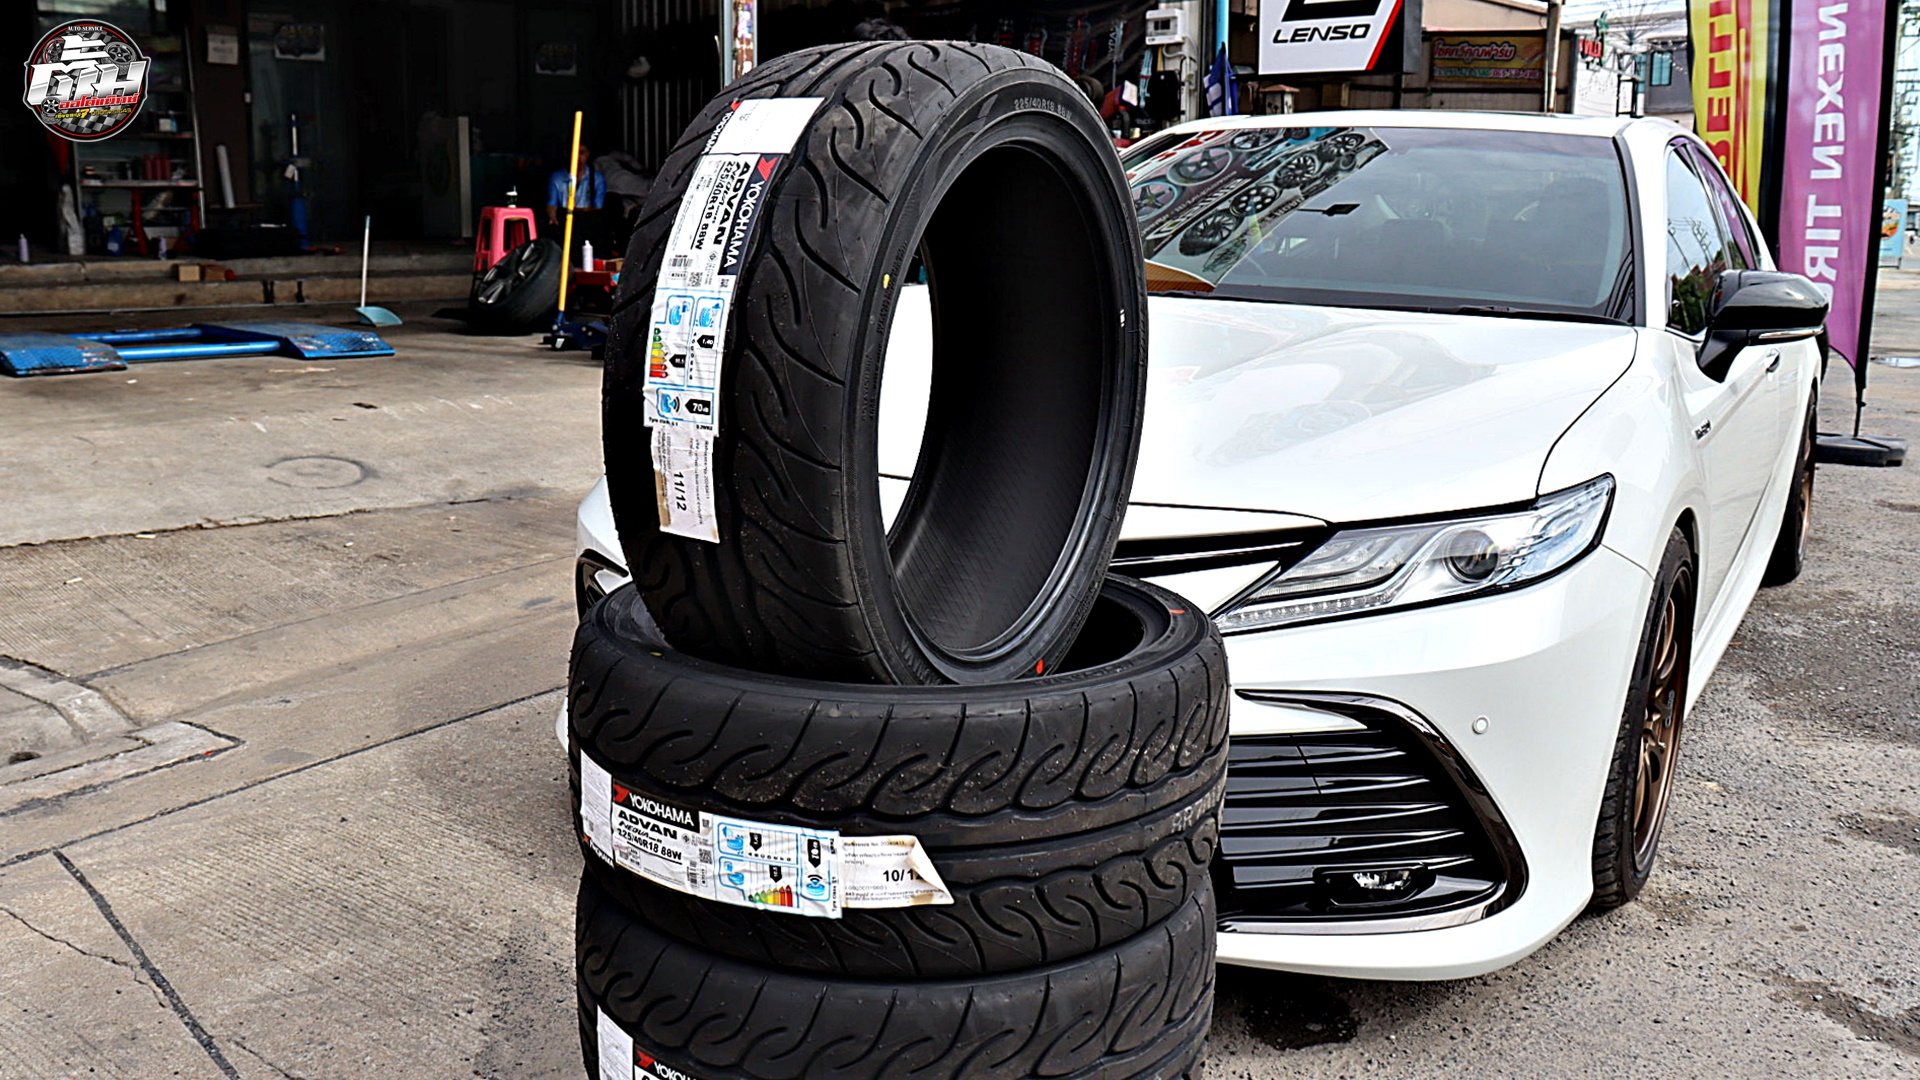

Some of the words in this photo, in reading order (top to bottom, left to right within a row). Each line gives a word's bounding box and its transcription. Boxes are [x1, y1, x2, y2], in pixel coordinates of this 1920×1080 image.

[1272, 23, 1371, 43] LENSO
[1013, 97, 1055, 111] 225/40R18
[704, 161, 732, 219] 225/40R18
[713, 161, 751, 245] ADVAN
[695, 223, 709, 250] 88W
[724, 181, 765, 268] YOKOHAMA
[673, 472, 687, 511] 11/12
[618, 810, 678, 840] ADVAN
[629, 792, 695, 826] YOKOHAMA
[617, 828, 659, 853] 225/40R18
[661, 846, 682, 860] 88W
[654, 1061, 697, 1080] YOKO
